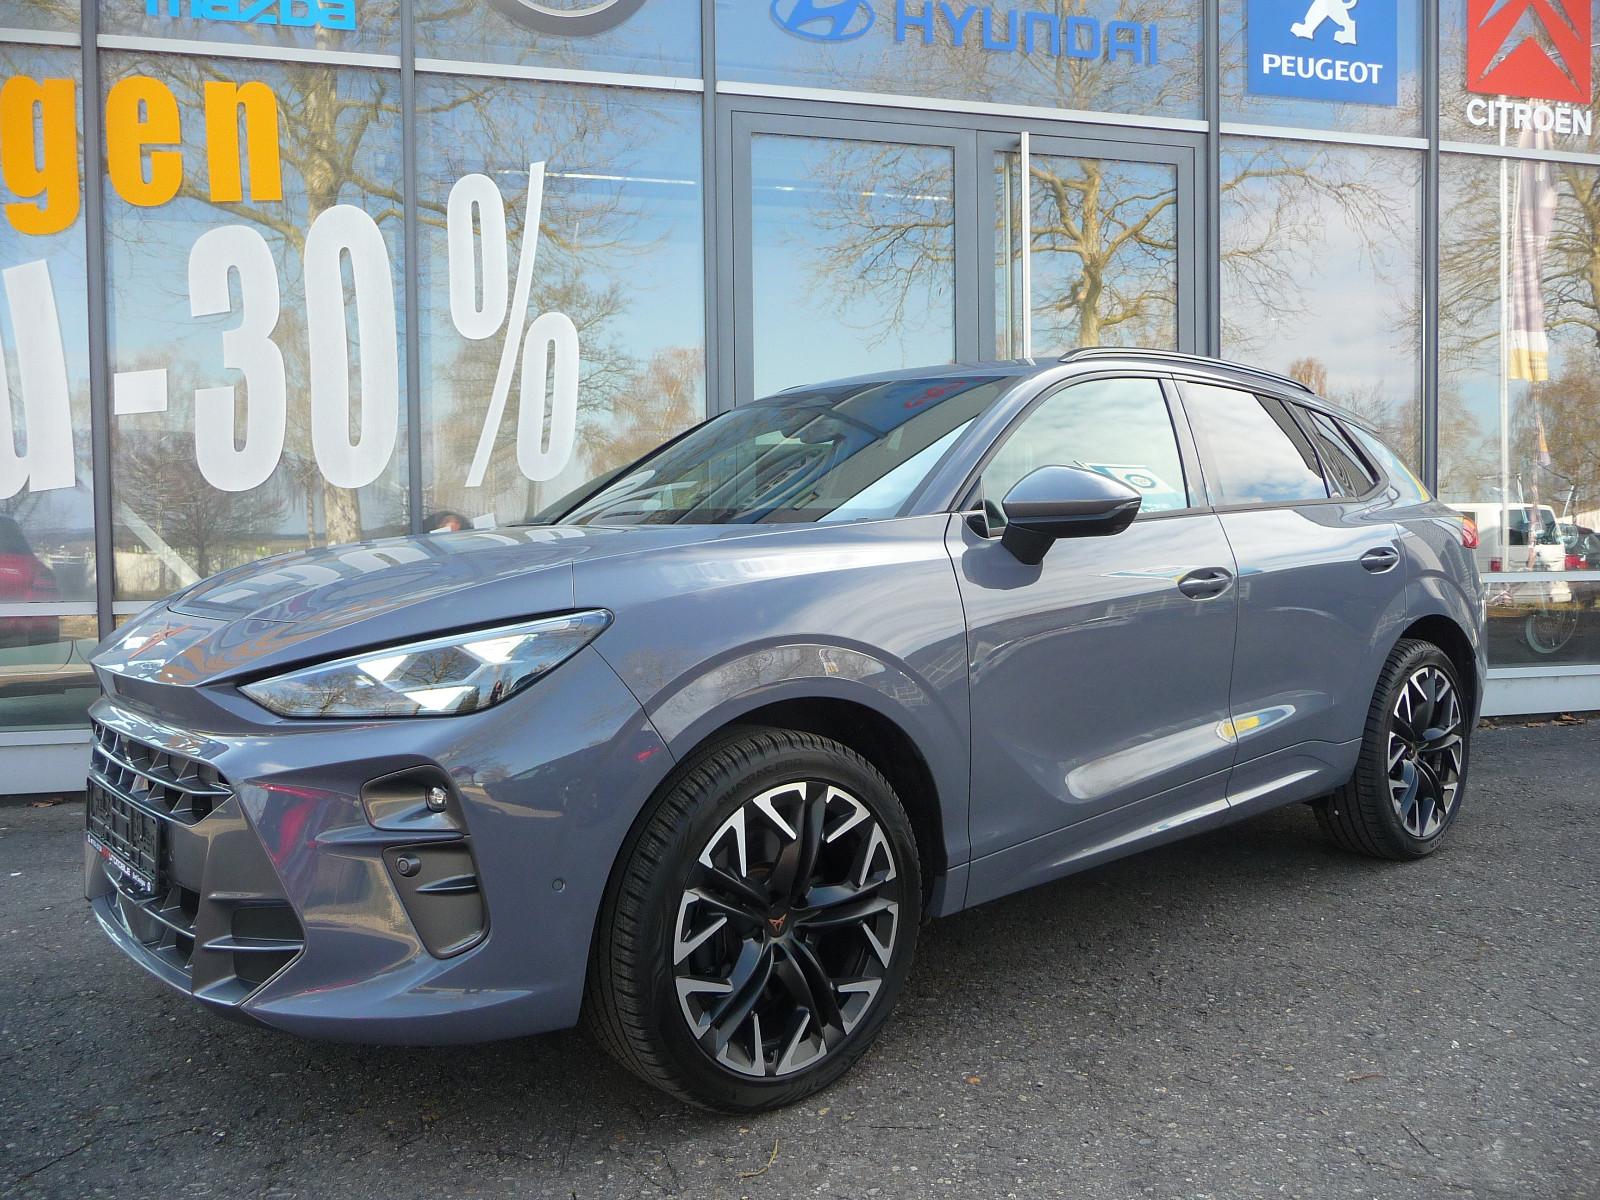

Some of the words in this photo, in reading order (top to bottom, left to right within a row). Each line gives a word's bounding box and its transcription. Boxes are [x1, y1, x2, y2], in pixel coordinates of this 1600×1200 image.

[896, 0, 1158, 65] HYUNDAI
[1262, 53, 1383, 85] PEUGEOT
[1466, 98, 1592, 136] CITROËN
[0, 74, 283, 236] gen
